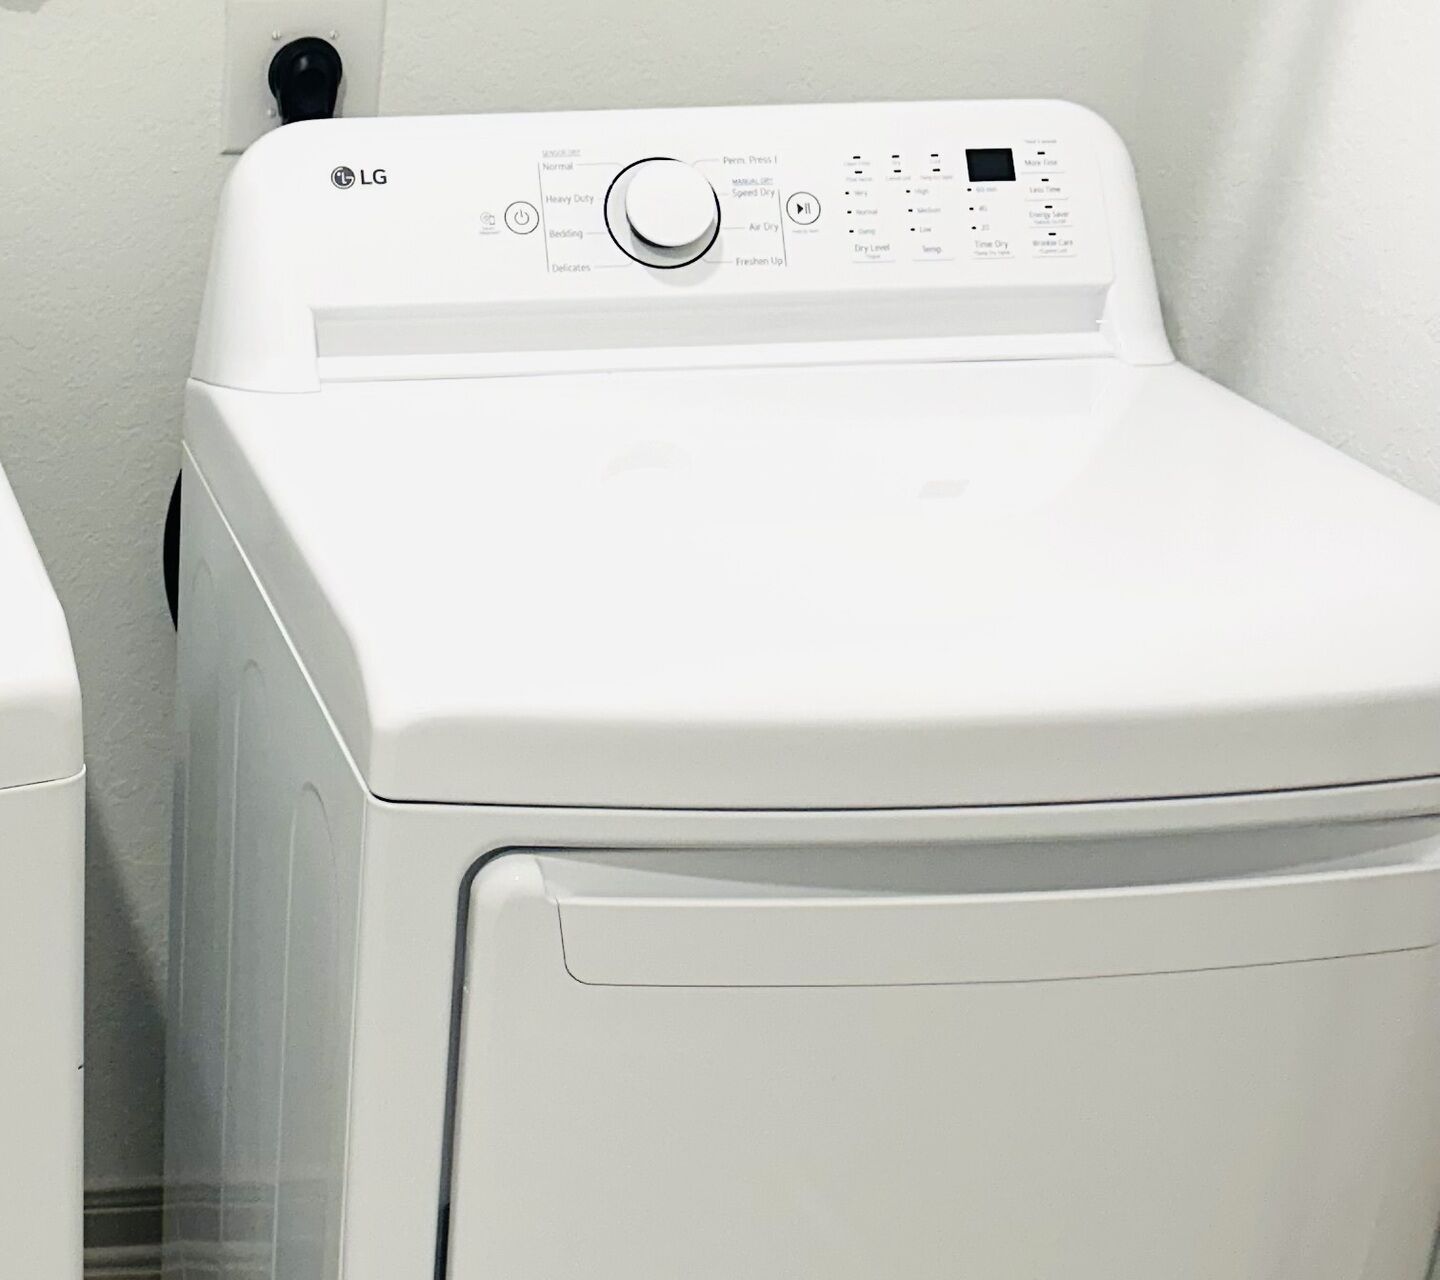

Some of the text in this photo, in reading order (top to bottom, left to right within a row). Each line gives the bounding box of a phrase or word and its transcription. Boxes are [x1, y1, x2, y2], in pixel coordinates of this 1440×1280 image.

[749, 154, 772, 165] Press
[543, 162, 574, 171] Normal
[360, 169, 388, 185] LG
[732, 187, 776, 199] Speed Dry
[546, 193, 595, 205] Heavy Duty
[749, 222, 779, 232] Air Dry
[549, 229, 584, 240] Bedding
[854, 243, 891, 254] Dry Level
[735, 255, 784, 266] Freshen Up
[551, 263, 591, 273] Delicates
